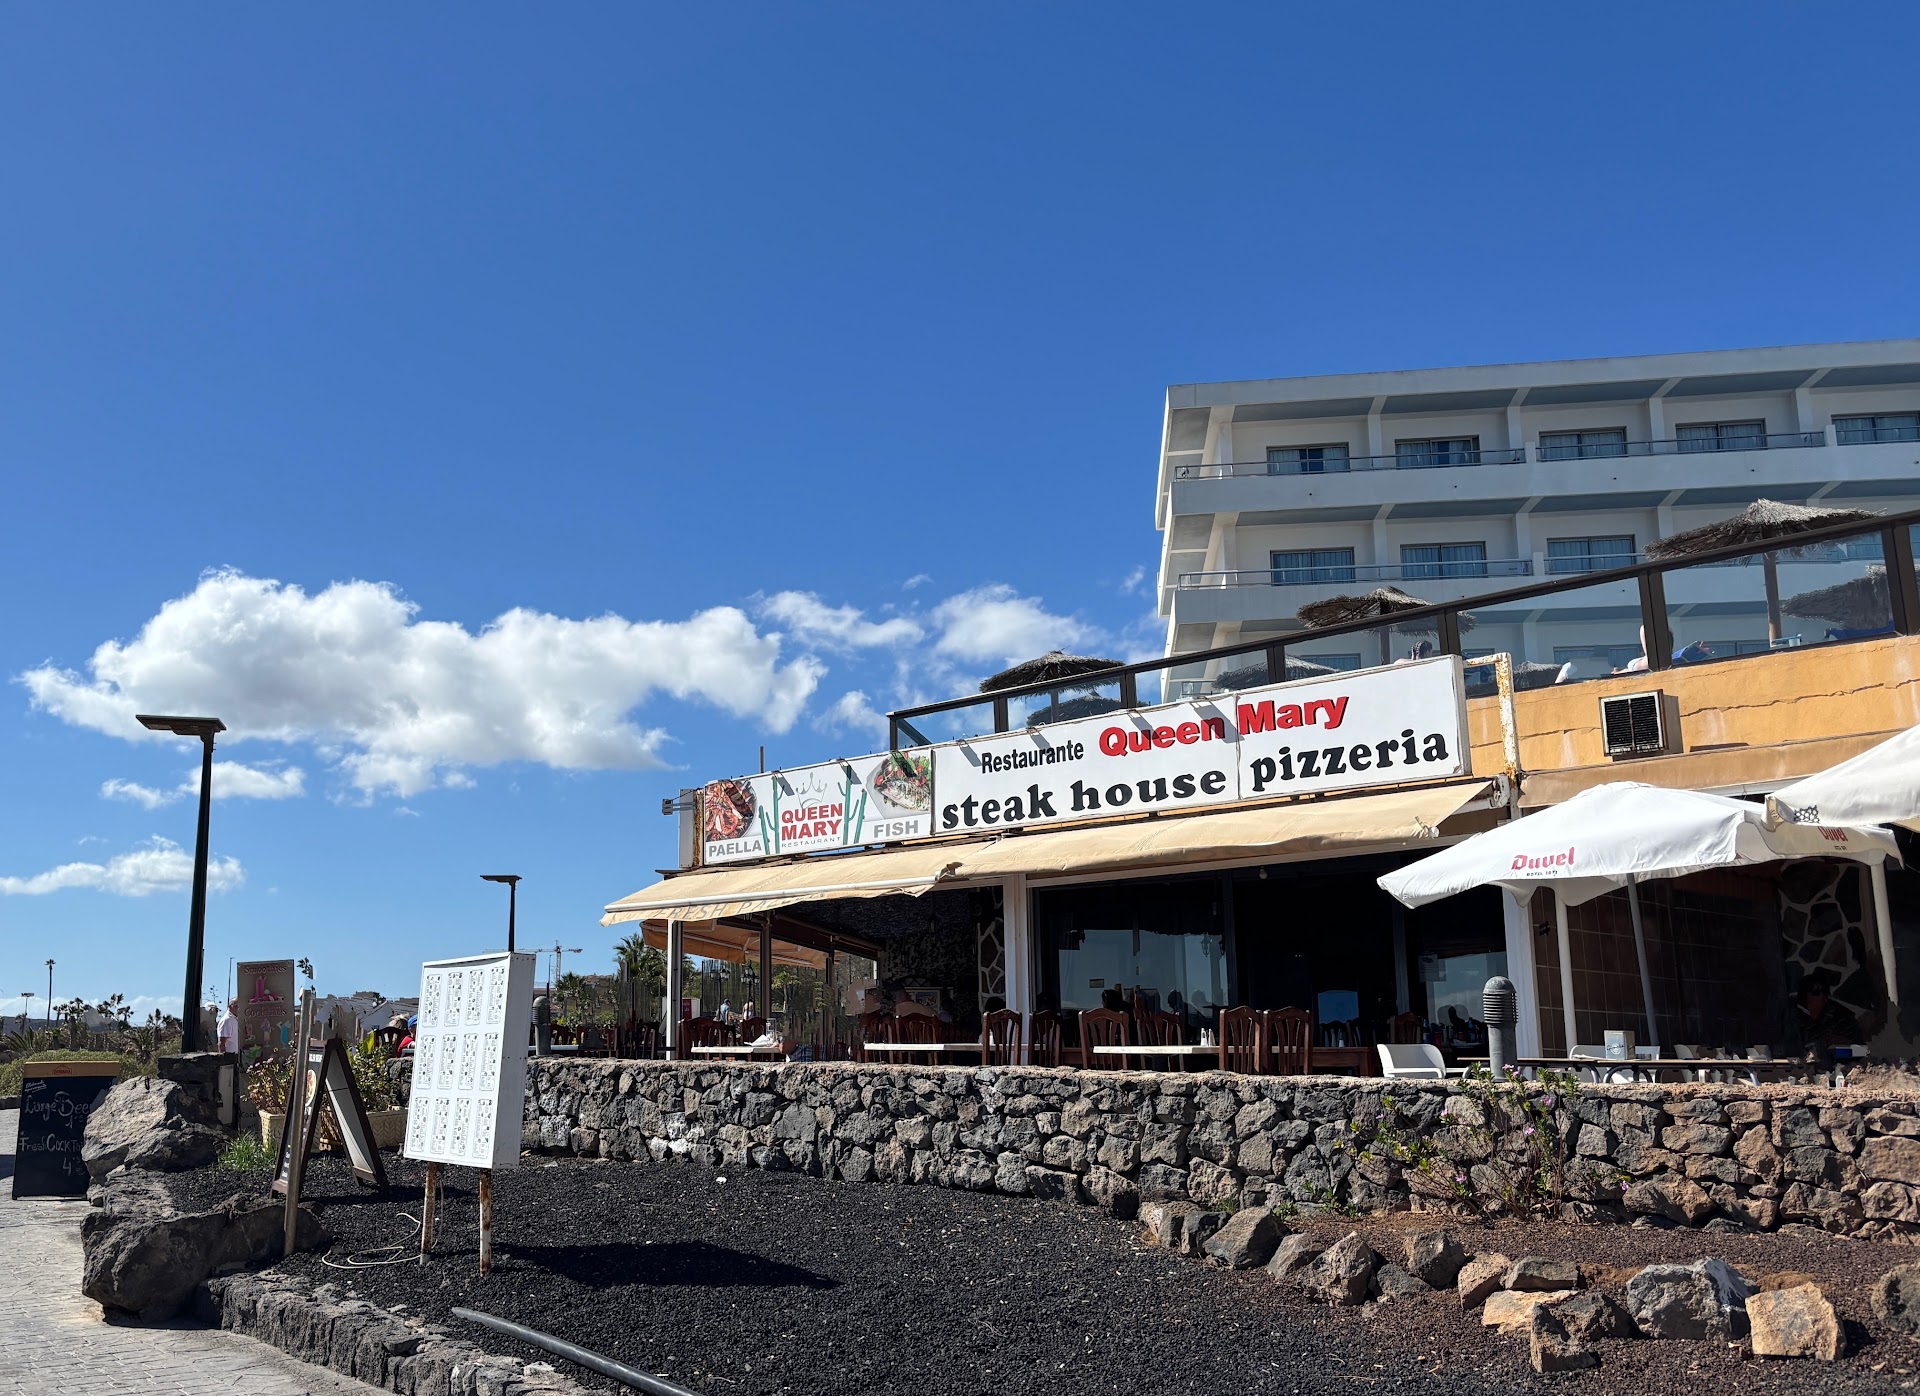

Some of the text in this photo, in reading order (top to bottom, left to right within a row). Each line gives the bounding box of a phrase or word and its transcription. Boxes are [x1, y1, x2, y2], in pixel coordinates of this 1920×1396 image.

[981, 695, 1350, 774] Restaurante Queen Mary
[942, 728, 1449, 830] steak house pizzeria
[781, 802, 843, 825] QUEEN
[781, 819, 843, 841] MARY
[873, 819, 919, 838] FISH
[708, 839, 762, 858] PAELLA
[781, 836, 842, 848] RESTAURANT
[1510, 846, 1576, 871] Duvel
[653, 902, 728, 920] FRESH
[243, 965, 287, 975] Smoothies
[244, 1005, 288, 1018] Cocktails
[24, 1090, 91, 1122] Large Bee
